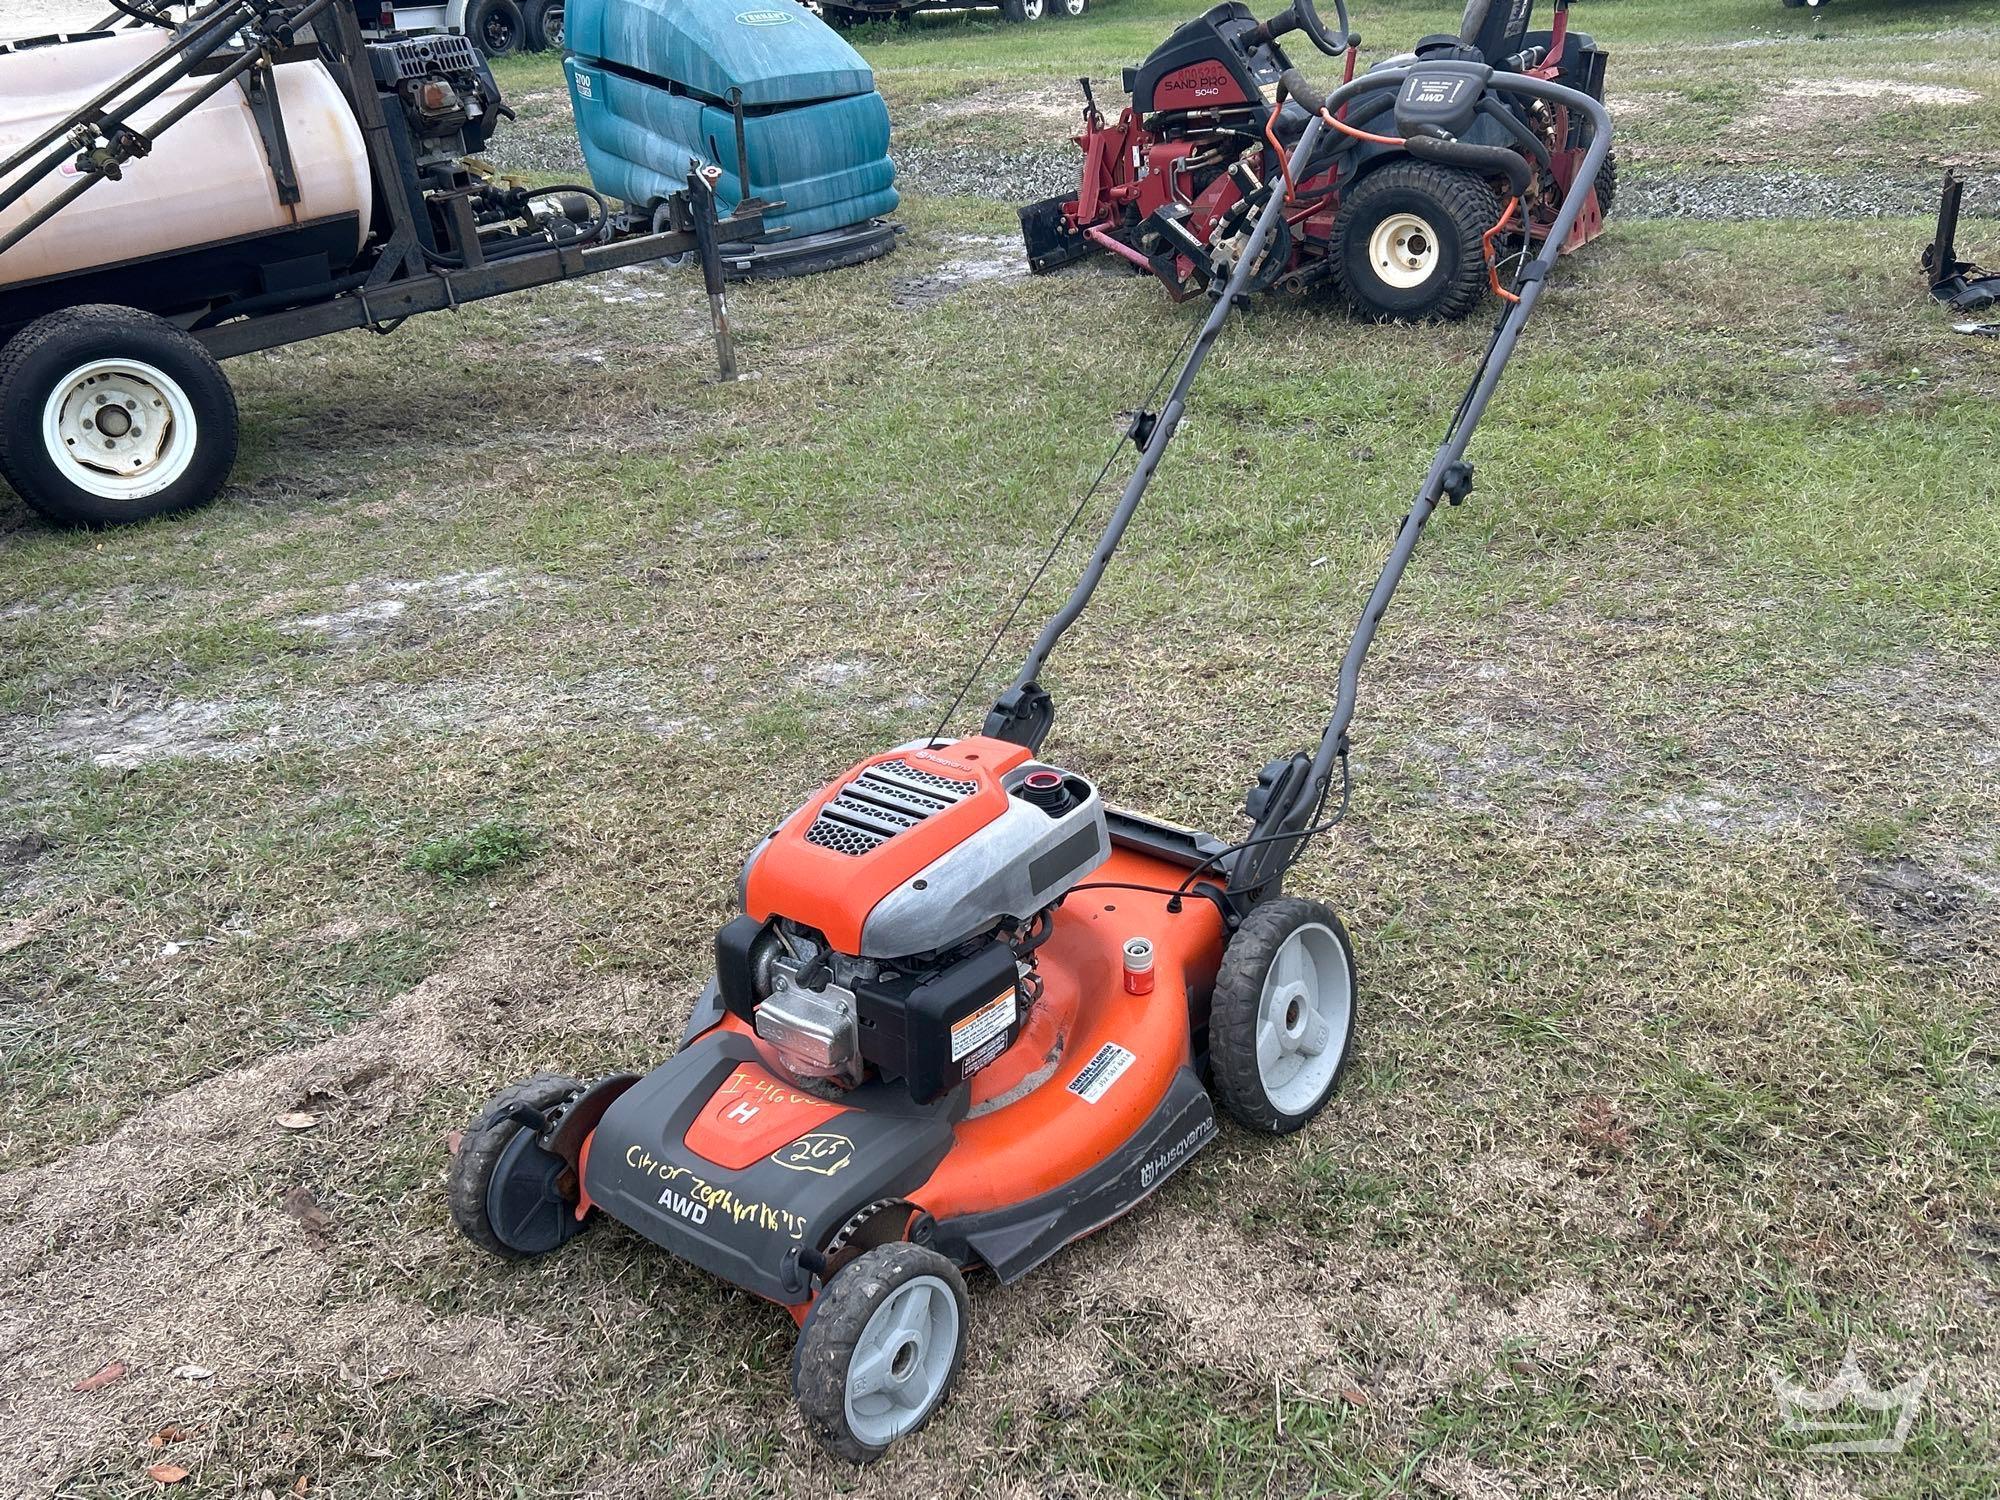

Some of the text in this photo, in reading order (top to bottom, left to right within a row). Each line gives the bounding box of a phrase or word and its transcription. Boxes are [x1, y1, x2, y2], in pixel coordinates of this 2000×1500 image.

[574, 71, 591, 87] 5700
[1165, 75, 1228, 91] SAND PRO
[1195, 87, 1219, 96] 5040
[1416, 93, 1445, 103] AWD
[1069, 1066, 1094, 1090] CENTRAL
[1091, 1044, 1113, 1066] FLORIDA
[790, 1139, 846, 1162] 265
[1154, 1116, 1213, 1176] Husqvarna
[658, 1187, 708, 1225] AWD
